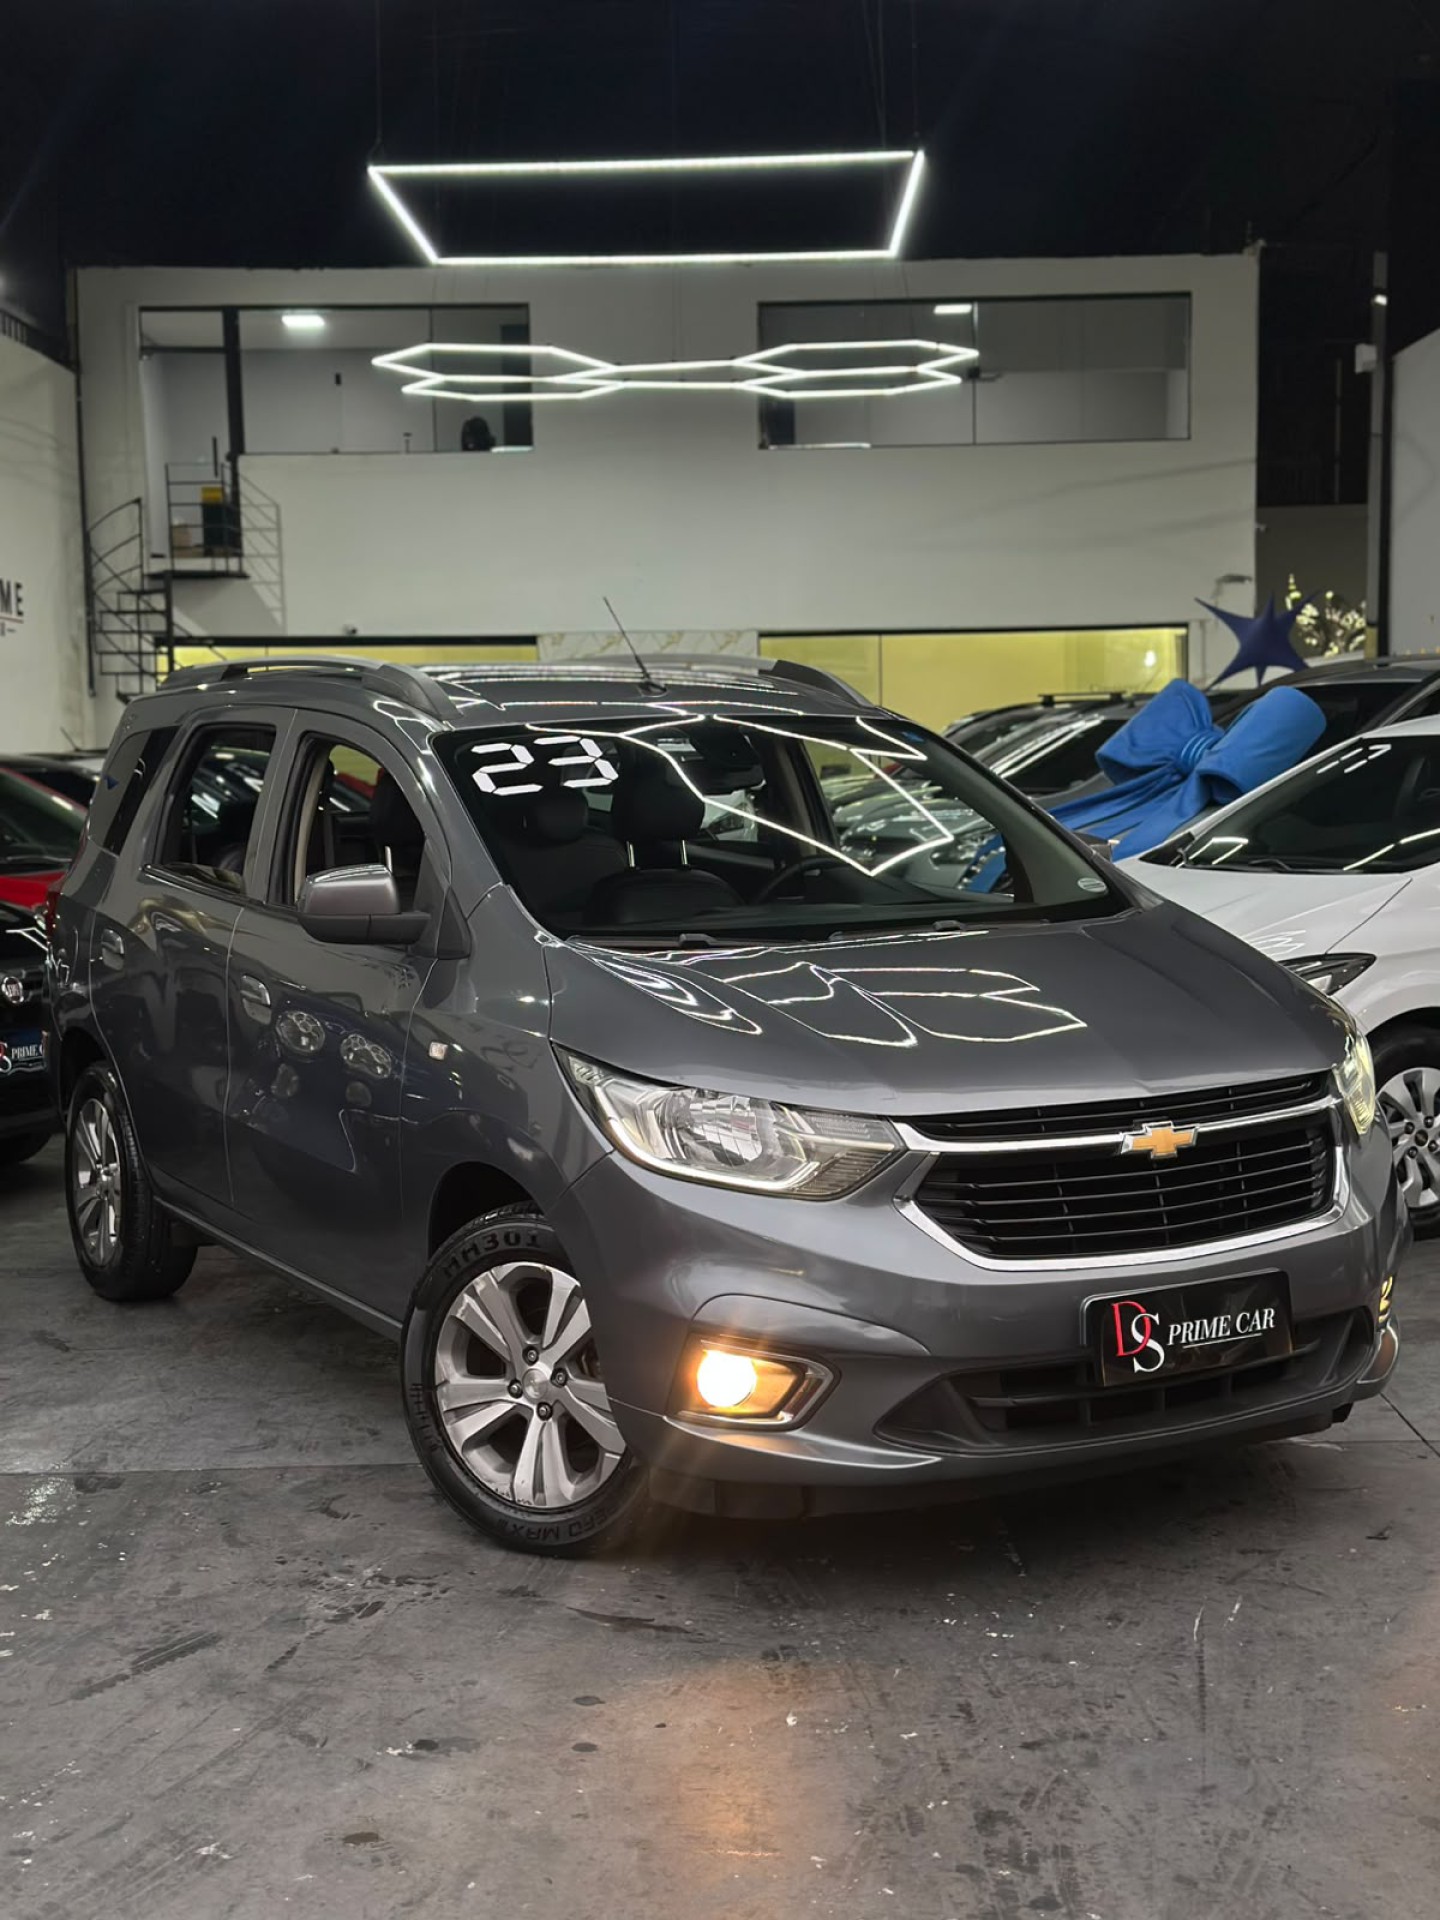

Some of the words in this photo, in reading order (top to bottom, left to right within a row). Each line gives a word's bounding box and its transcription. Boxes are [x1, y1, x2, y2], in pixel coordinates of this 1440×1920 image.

[471, 735, 619, 796] 23
[11, 1044, 38, 1060] PRIME
[1111, 1301, 1165, 1373] DS
[1167, 1314, 1232, 1346] PRIME
[1235, 1307, 1276, 1334] CAR
